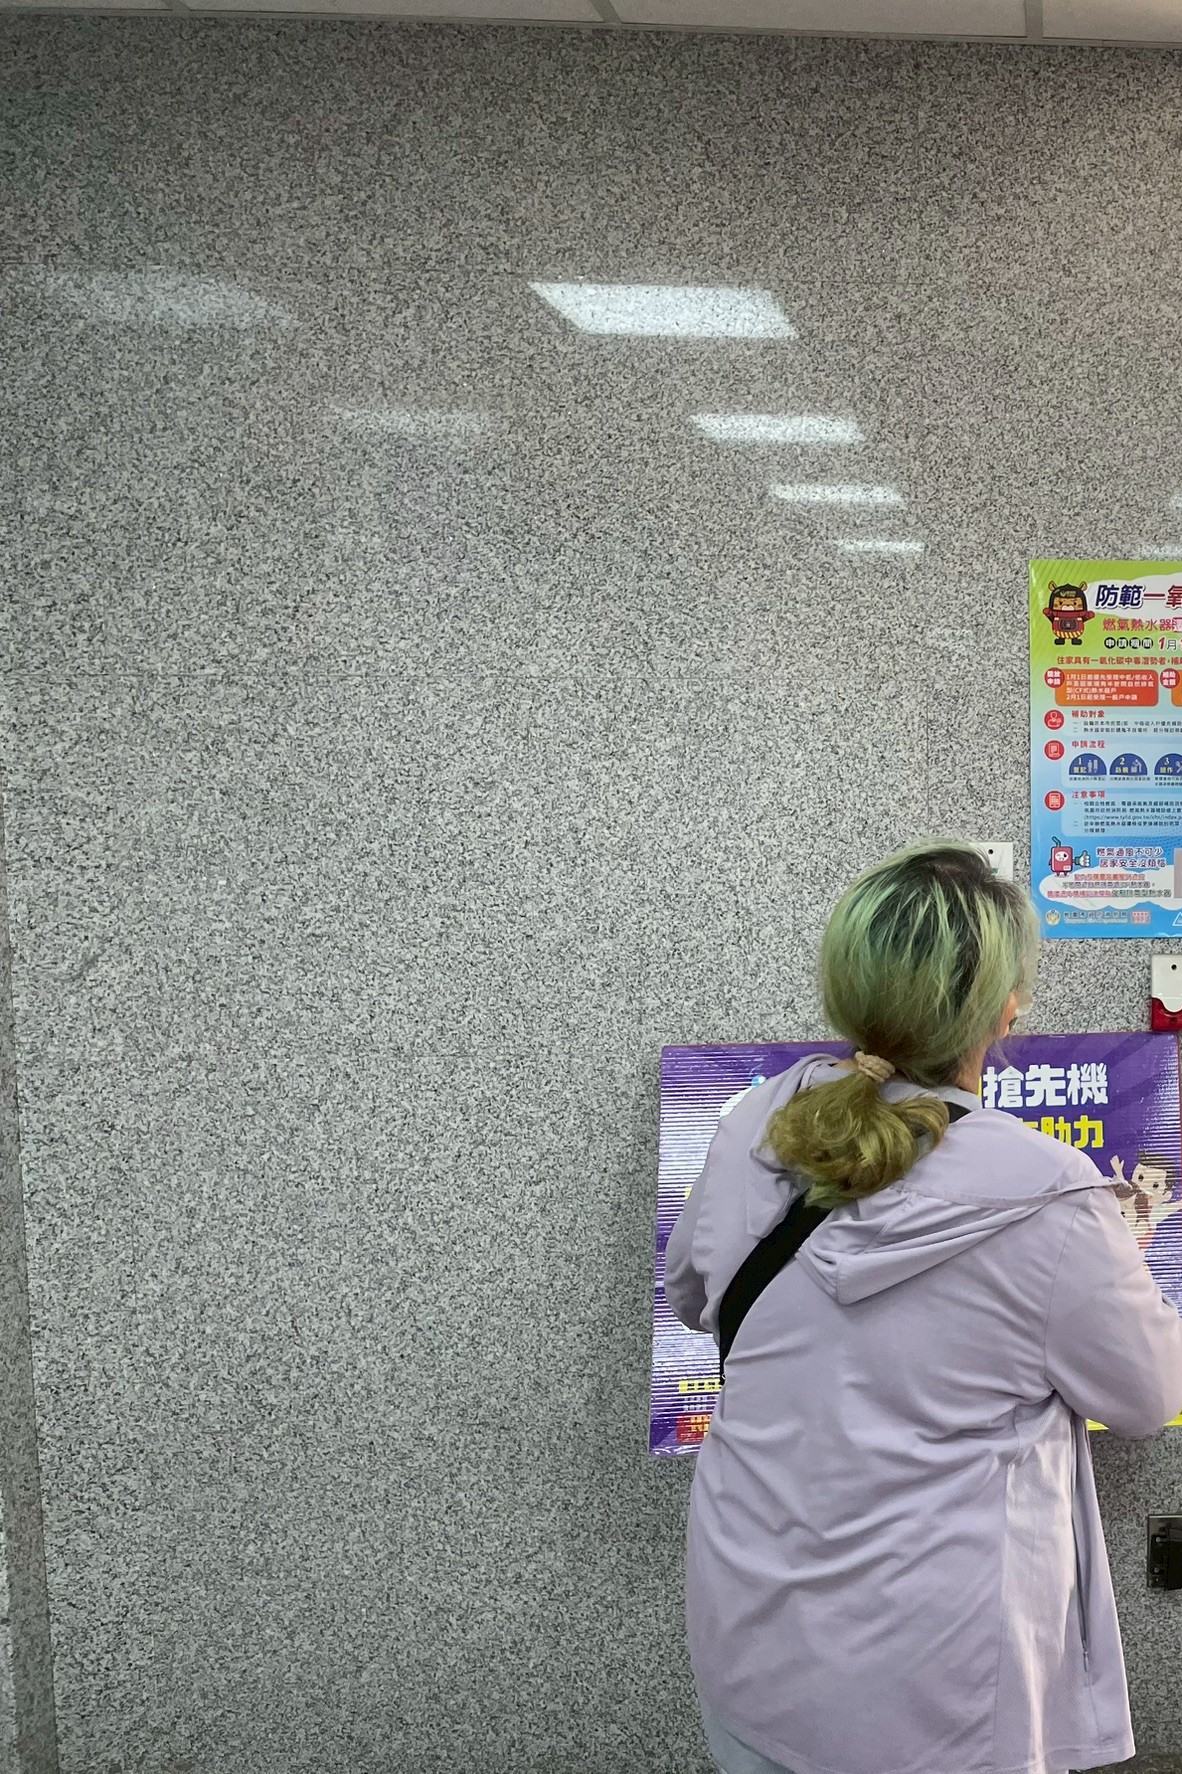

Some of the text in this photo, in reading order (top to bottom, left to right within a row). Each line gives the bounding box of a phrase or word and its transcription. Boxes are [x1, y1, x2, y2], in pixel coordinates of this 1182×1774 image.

[1104, 637, 1154, 649] 申請期間
[1071, 710, 1106, 718] 補助對象
[1071, 740, 1106, 748] 申請流程
[1072, 791, 1106, 799] 注意事項
[1097, 847, 1163, 857] 燃氣通風不可少
[1100, 859, 1166, 868] 居家安全沒煩惱
[983, 1063, 1109, 1108] 搶先機
[1017, 1115, 1104, 1149] 助力
